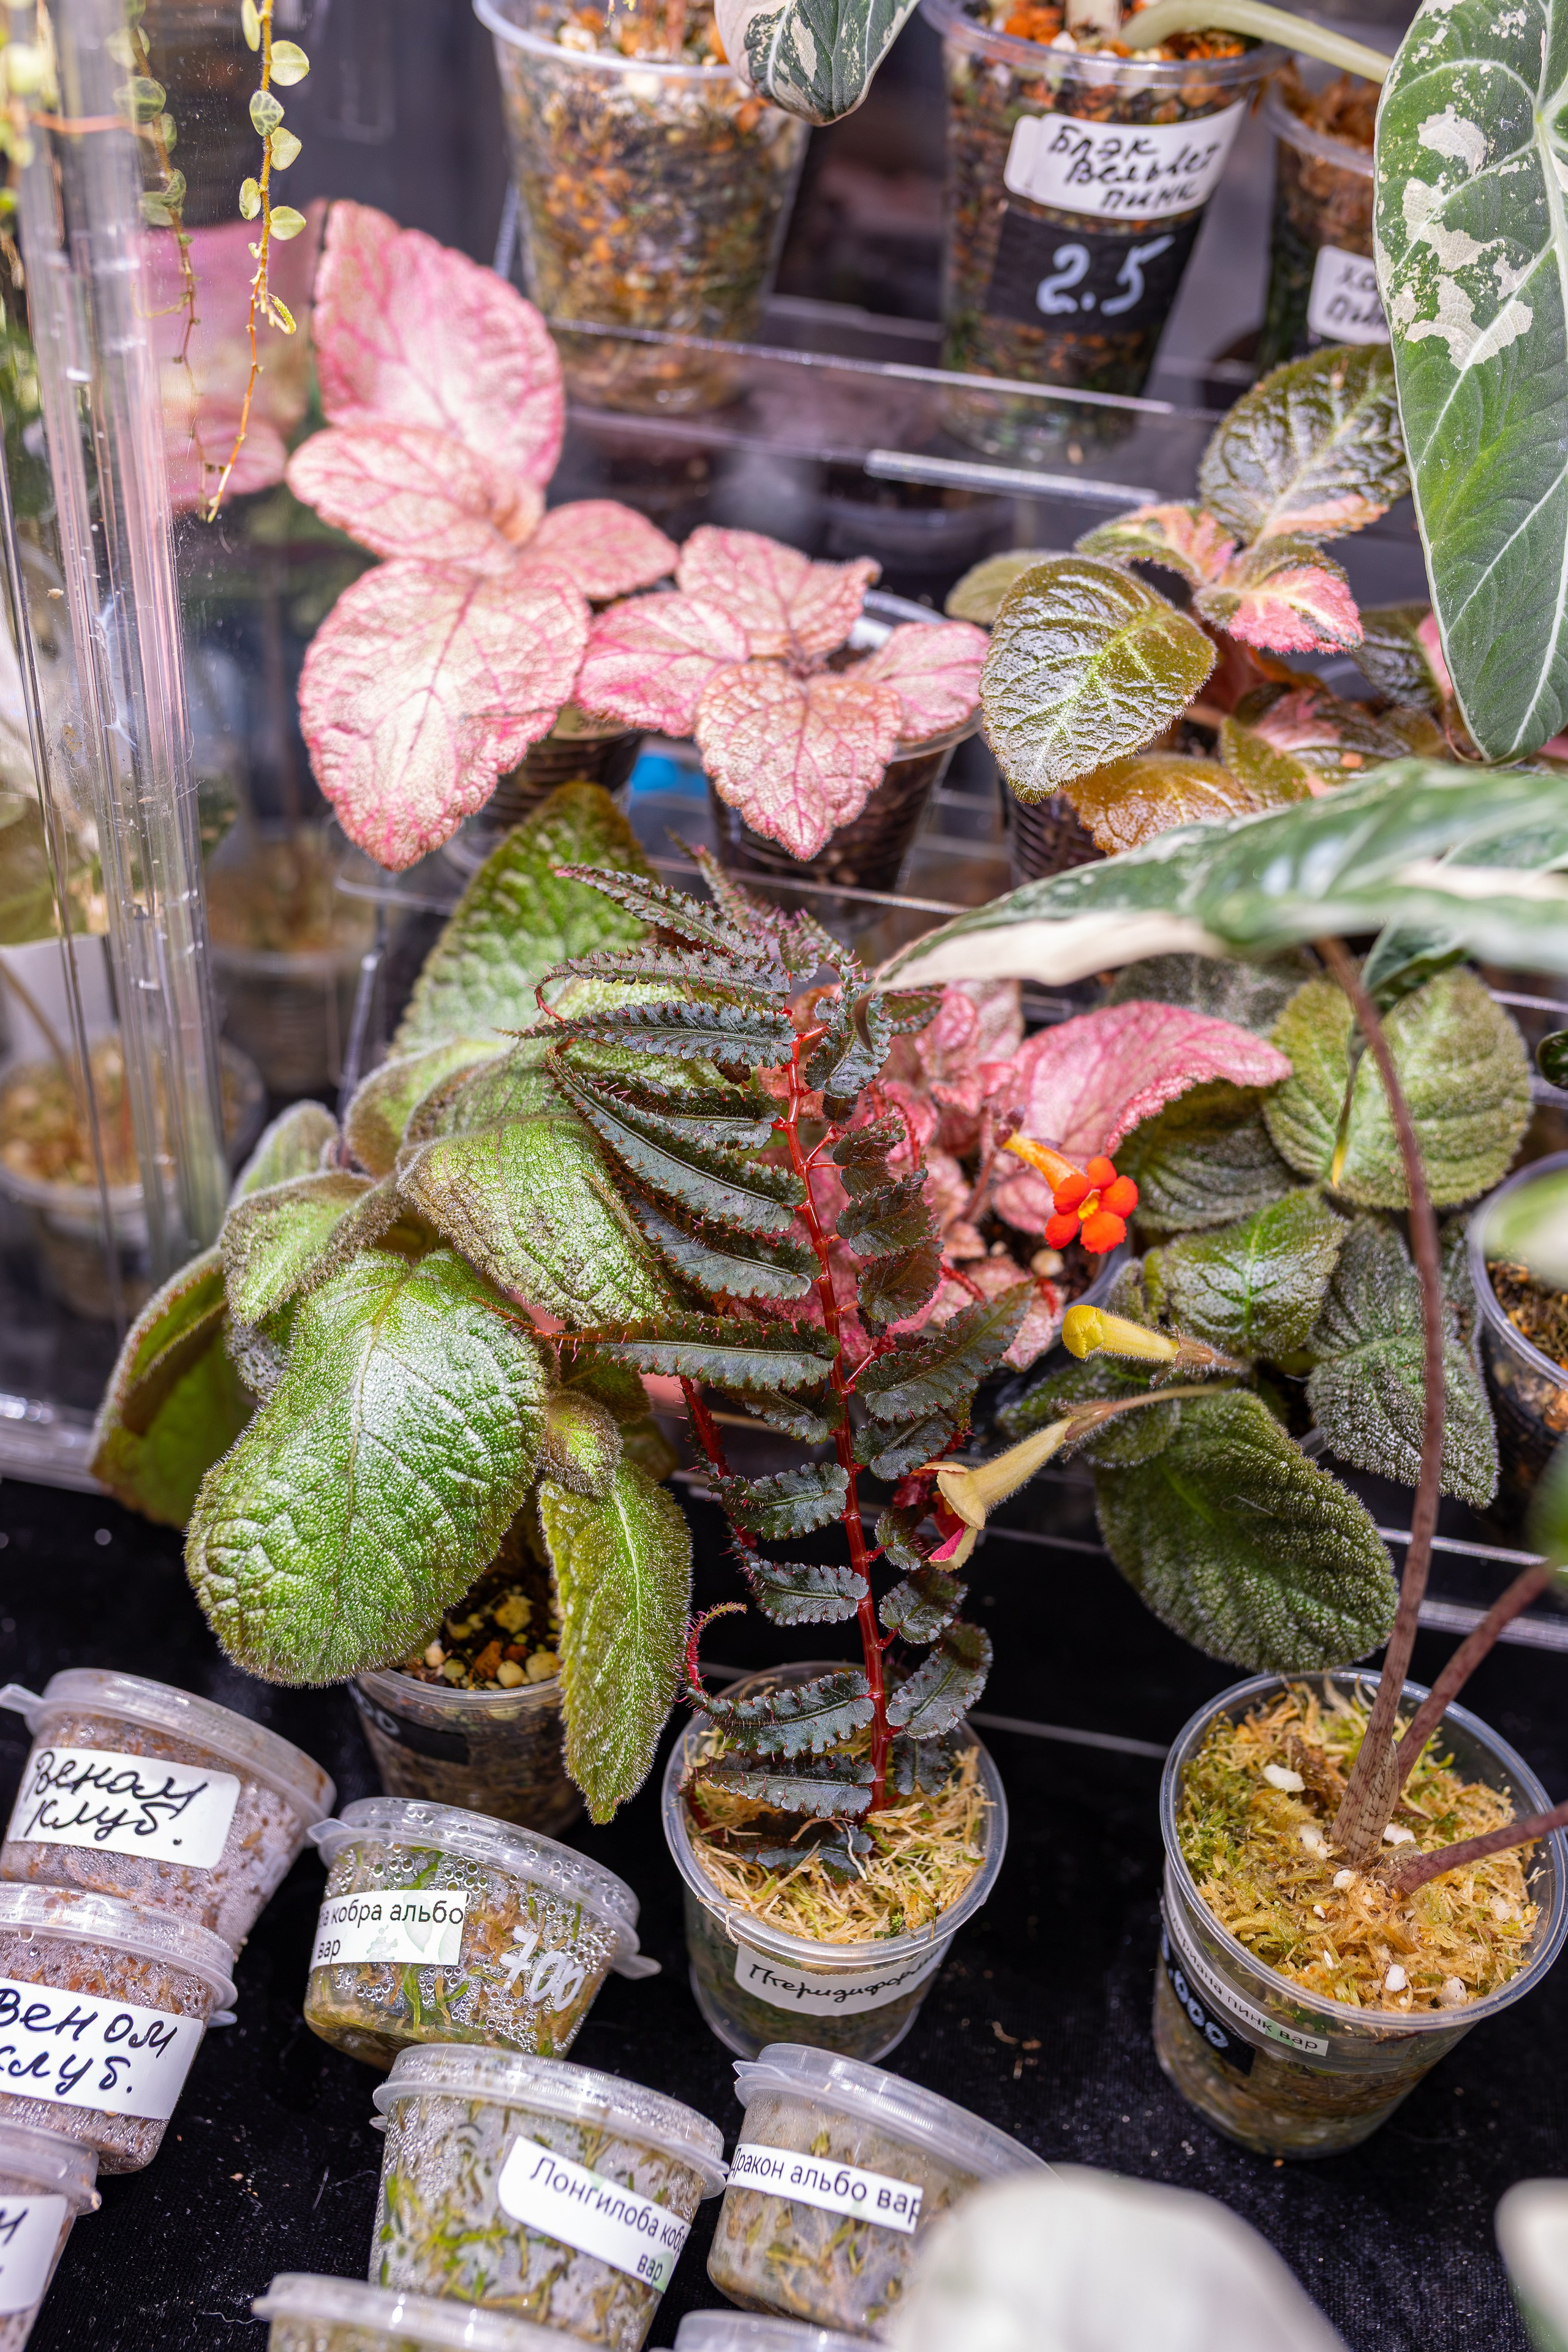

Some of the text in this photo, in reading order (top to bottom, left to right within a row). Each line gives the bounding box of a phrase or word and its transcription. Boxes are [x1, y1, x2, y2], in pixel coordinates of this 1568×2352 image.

[1036, 234, 1175, 316] 2.5
[331, 1898, 382, 1929] кобра
[390, 1899, 464, 1925] альбо
[1280, 2029, 1318, 2050] вар
[730, 2147, 785, 2179] Дракон
[790, 2165, 867, 2202] альбо
[530, 2156, 687, 2260] Лонгилоба кобр
[636, 2255, 664, 2285] вар
